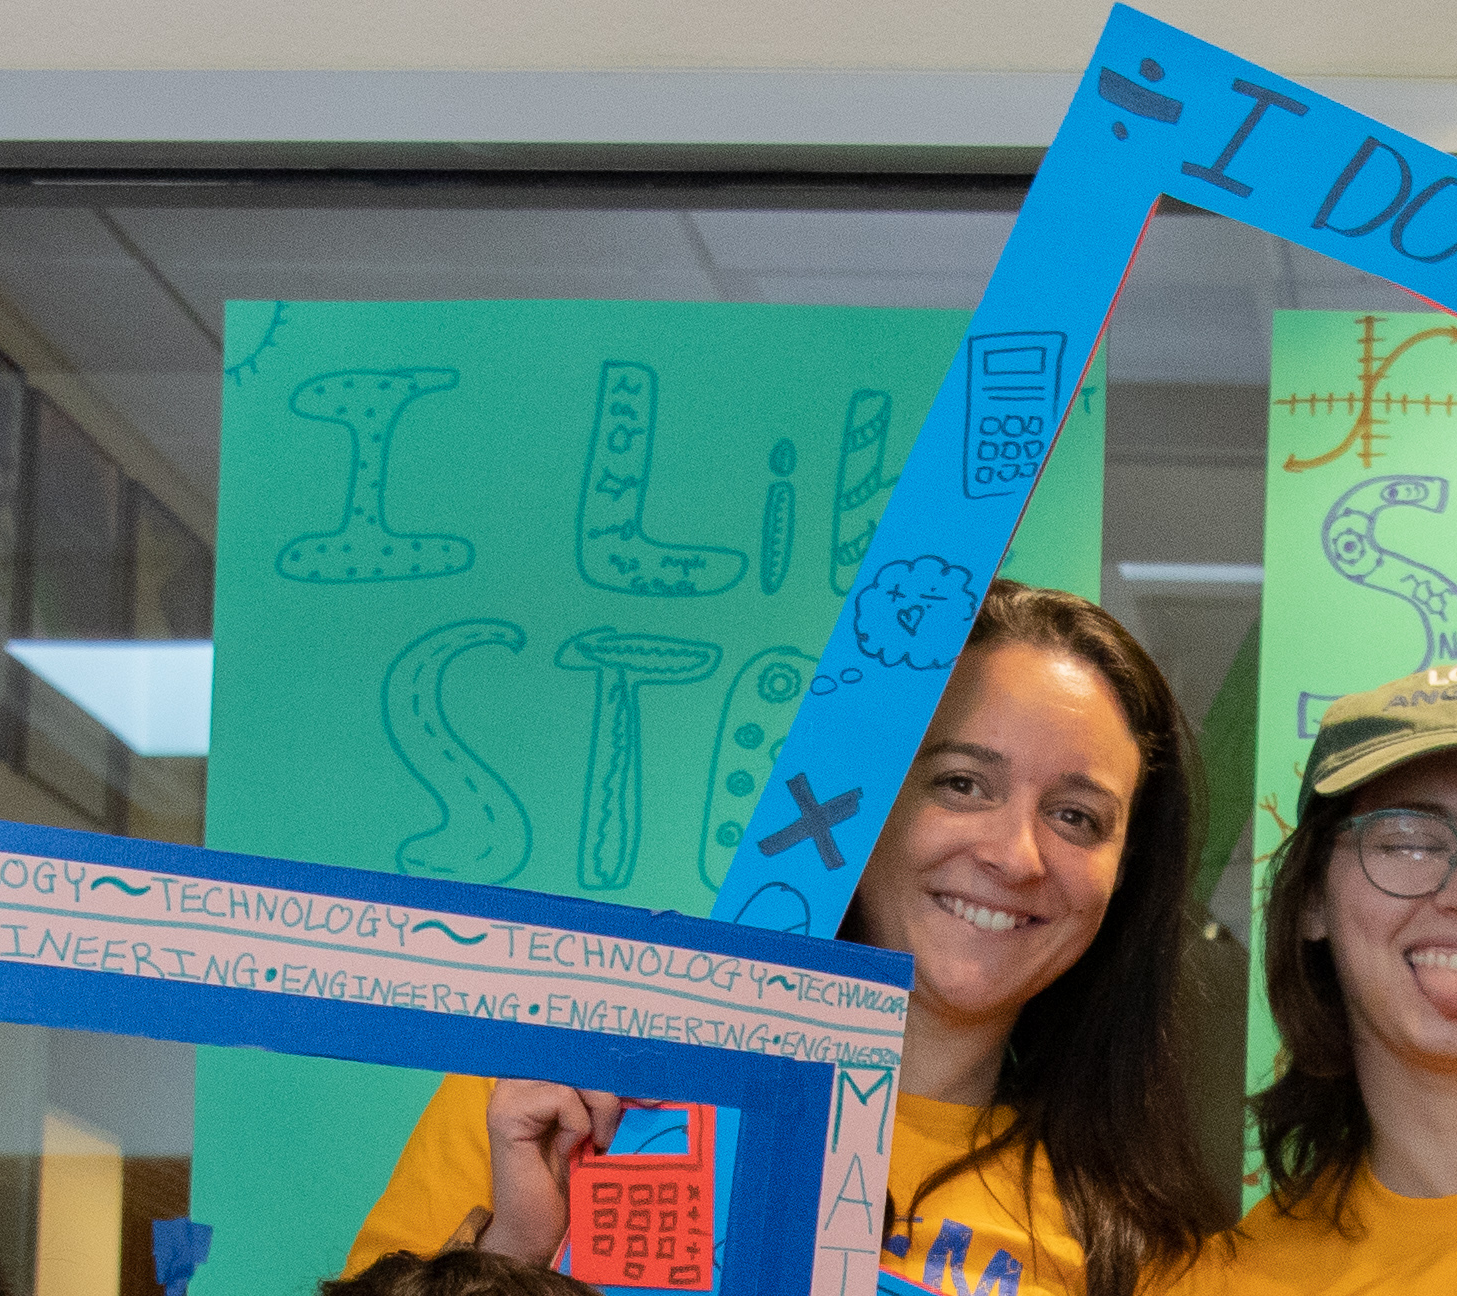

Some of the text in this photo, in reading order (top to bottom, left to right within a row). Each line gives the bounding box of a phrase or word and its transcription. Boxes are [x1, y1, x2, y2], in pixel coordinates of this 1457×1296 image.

[1181, 79, 1309, 198] I
[277, 359, 898, 597] I Li
[153, 877, 413, 946] TECHNOLOGY
[490, 923, 767, 998] TECHNOLOGY
[282, 964, 521, 1021] ENGINEERING
[547, 996, 772, 1054] ENGINEERING
